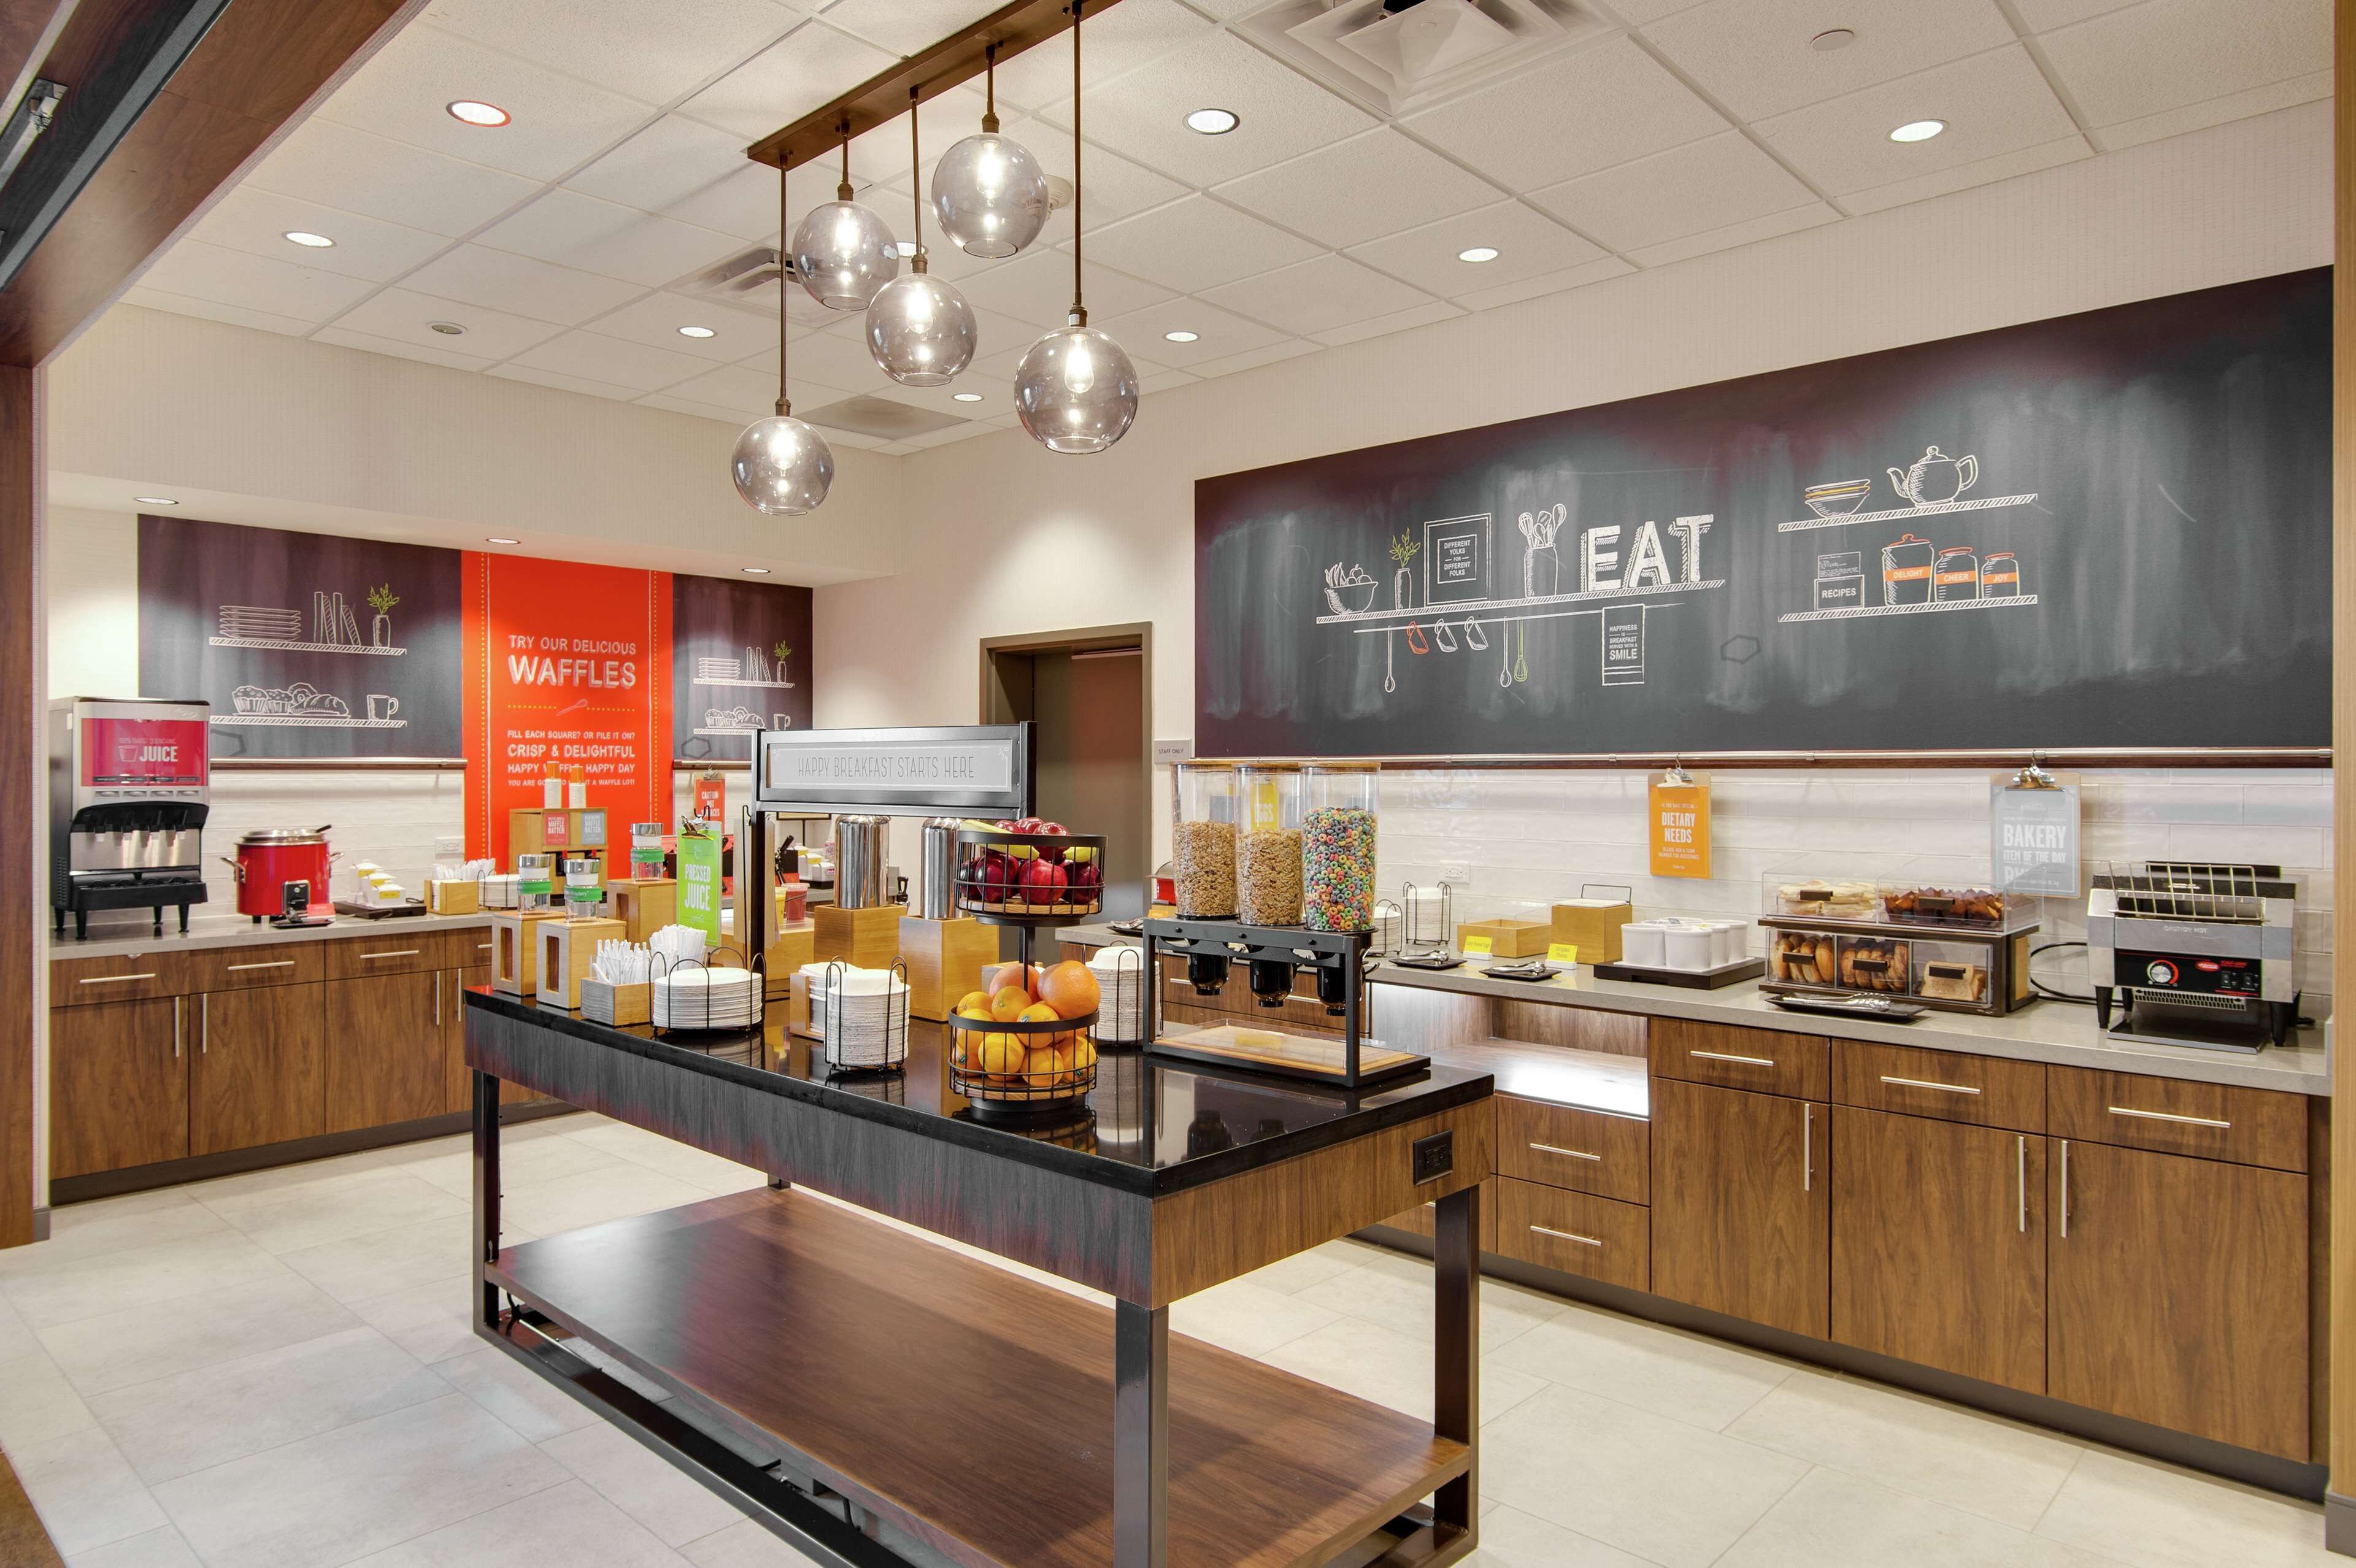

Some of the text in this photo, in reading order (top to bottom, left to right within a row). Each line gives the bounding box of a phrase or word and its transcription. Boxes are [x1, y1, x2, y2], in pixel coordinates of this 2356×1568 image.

[1444, 540, 1471, 549] DIFFERENT
[1581, 514, 1714, 592] EAT
[1444, 561, 1471, 571] DIFFERENT
[1893, 569, 1923, 578] DELIGHT
[1822, 588, 1856, 598] RECIPES
[509, 635, 636, 655] TRY OUR DELICIOUS
[1609, 648, 1638, 661] SMILE
[508, 655, 636, 690] WAFFLES
[507, 730, 522, 739] FILL
[139, 746, 178, 762] JUICE
[507, 744, 635, 758] CRISP & DELIGHTFUL
[508, 764, 539, 773] HAPPY
[586, 764, 615, 773] HAPPY
[618, 764, 635, 773] DAY
[798, 756, 974, 778] HAPPY BREAKFAST STARTS HERE
[1661, 812, 1695, 827] DIETARY
[1665, 828, 1692, 844] NEEDS
[2004, 824, 2066, 848] BAKERY
[2004, 850, 2067, 863] ITEM OF THE DAY
[685, 864, 710, 883] PRESSED
[685, 883, 710, 912] JUICE
